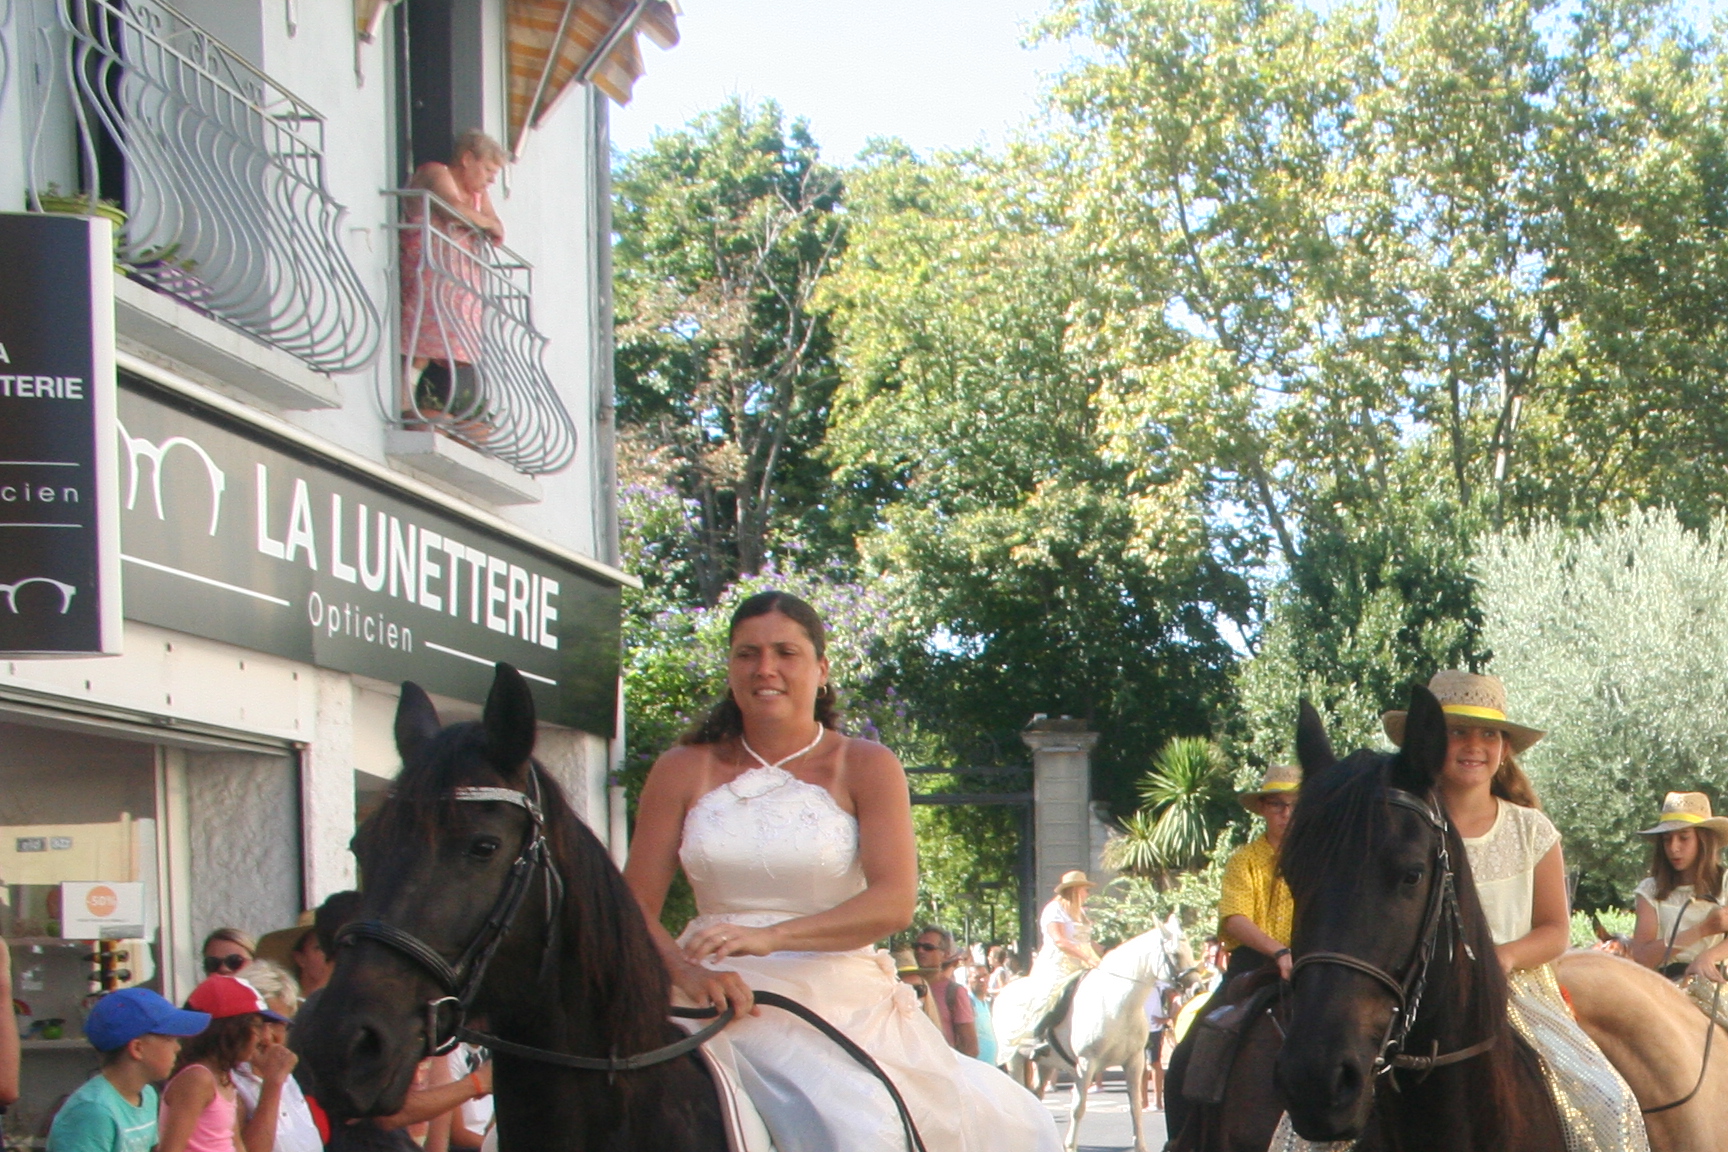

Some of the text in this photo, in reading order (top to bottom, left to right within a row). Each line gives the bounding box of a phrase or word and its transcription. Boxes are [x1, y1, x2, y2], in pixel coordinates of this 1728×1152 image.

[1, 482, 79, 503] cien
[256, 462, 560, 650] LA LUNETTERIE
[308, 591, 412, 652] Opticien
